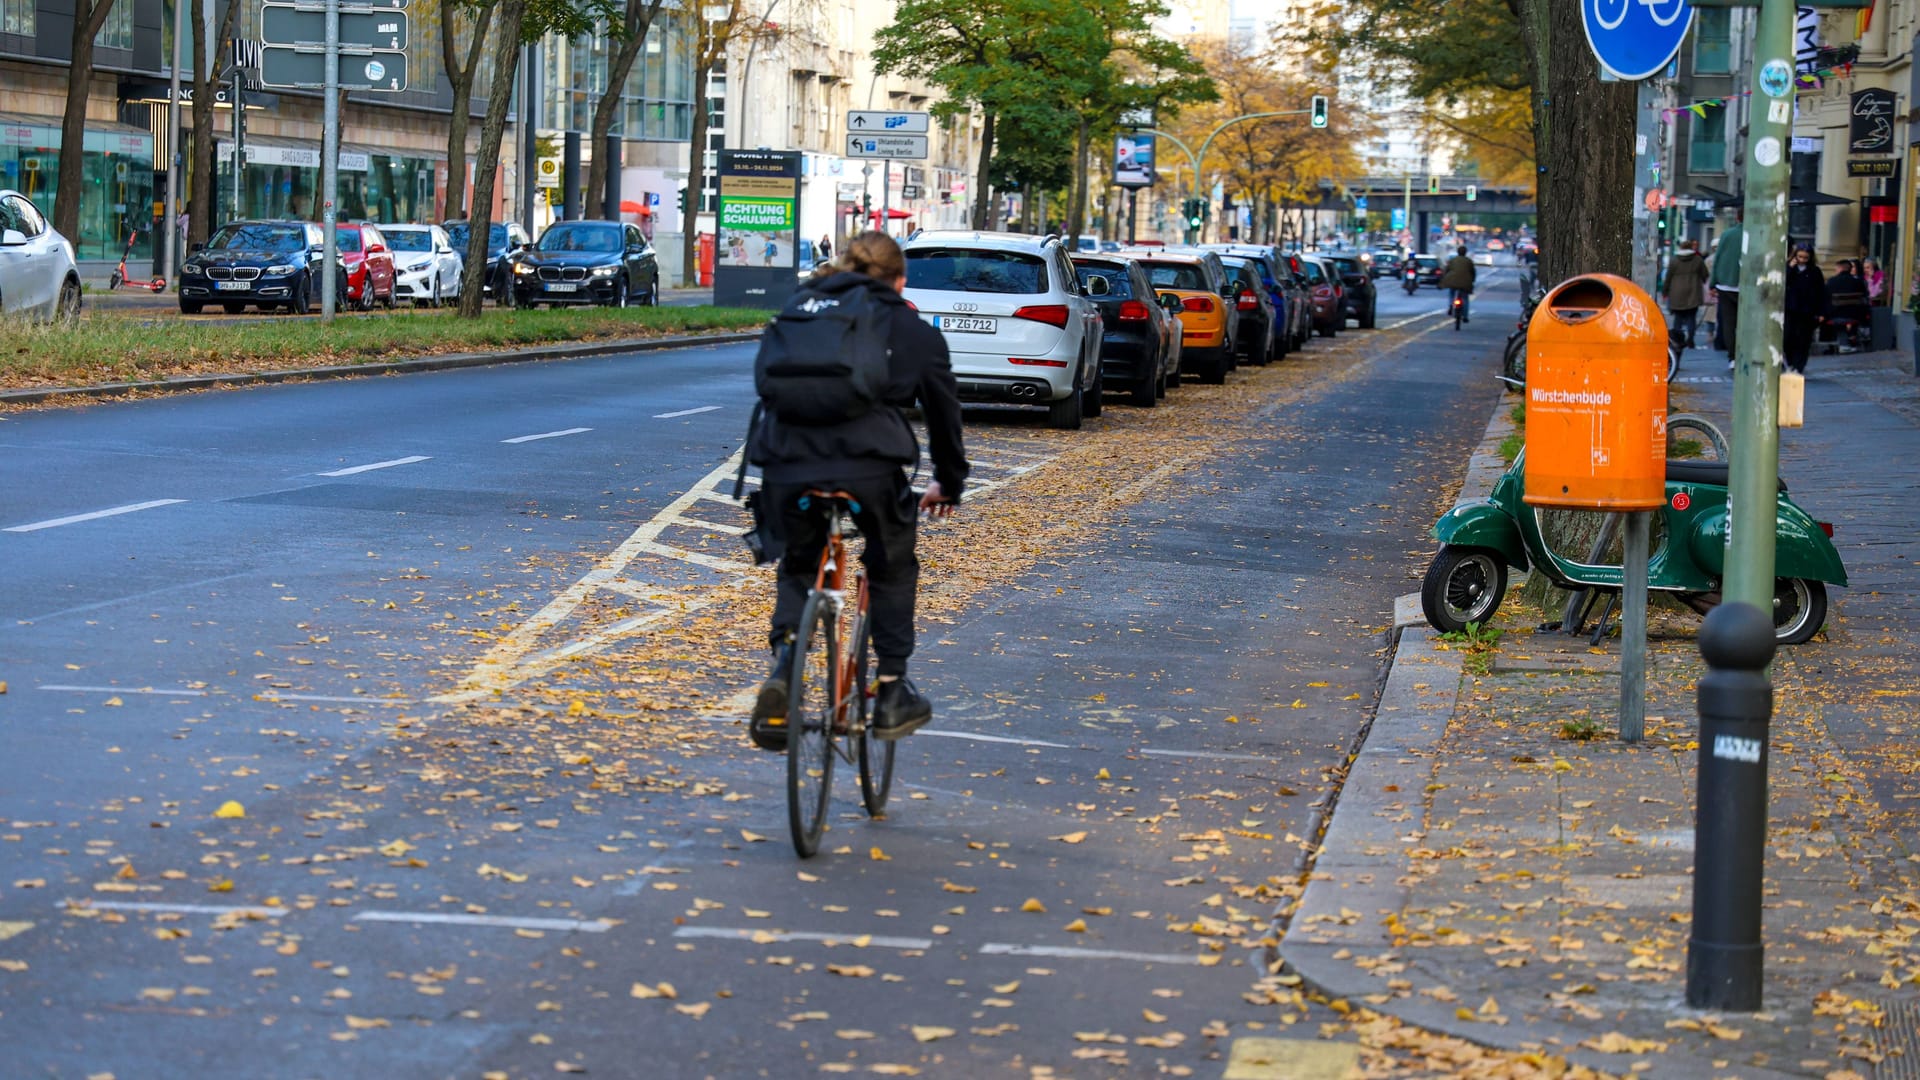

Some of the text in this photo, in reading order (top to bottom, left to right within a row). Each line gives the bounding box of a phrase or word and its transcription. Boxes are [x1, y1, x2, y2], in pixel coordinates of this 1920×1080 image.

[723, 203, 785, 215] ACHTUNG
[723, 214, 785, 225] SCHULWEG
[943, 318, 992, 330] B ZG 712
[1531, 387, 1611, 405] Würstchenbude
